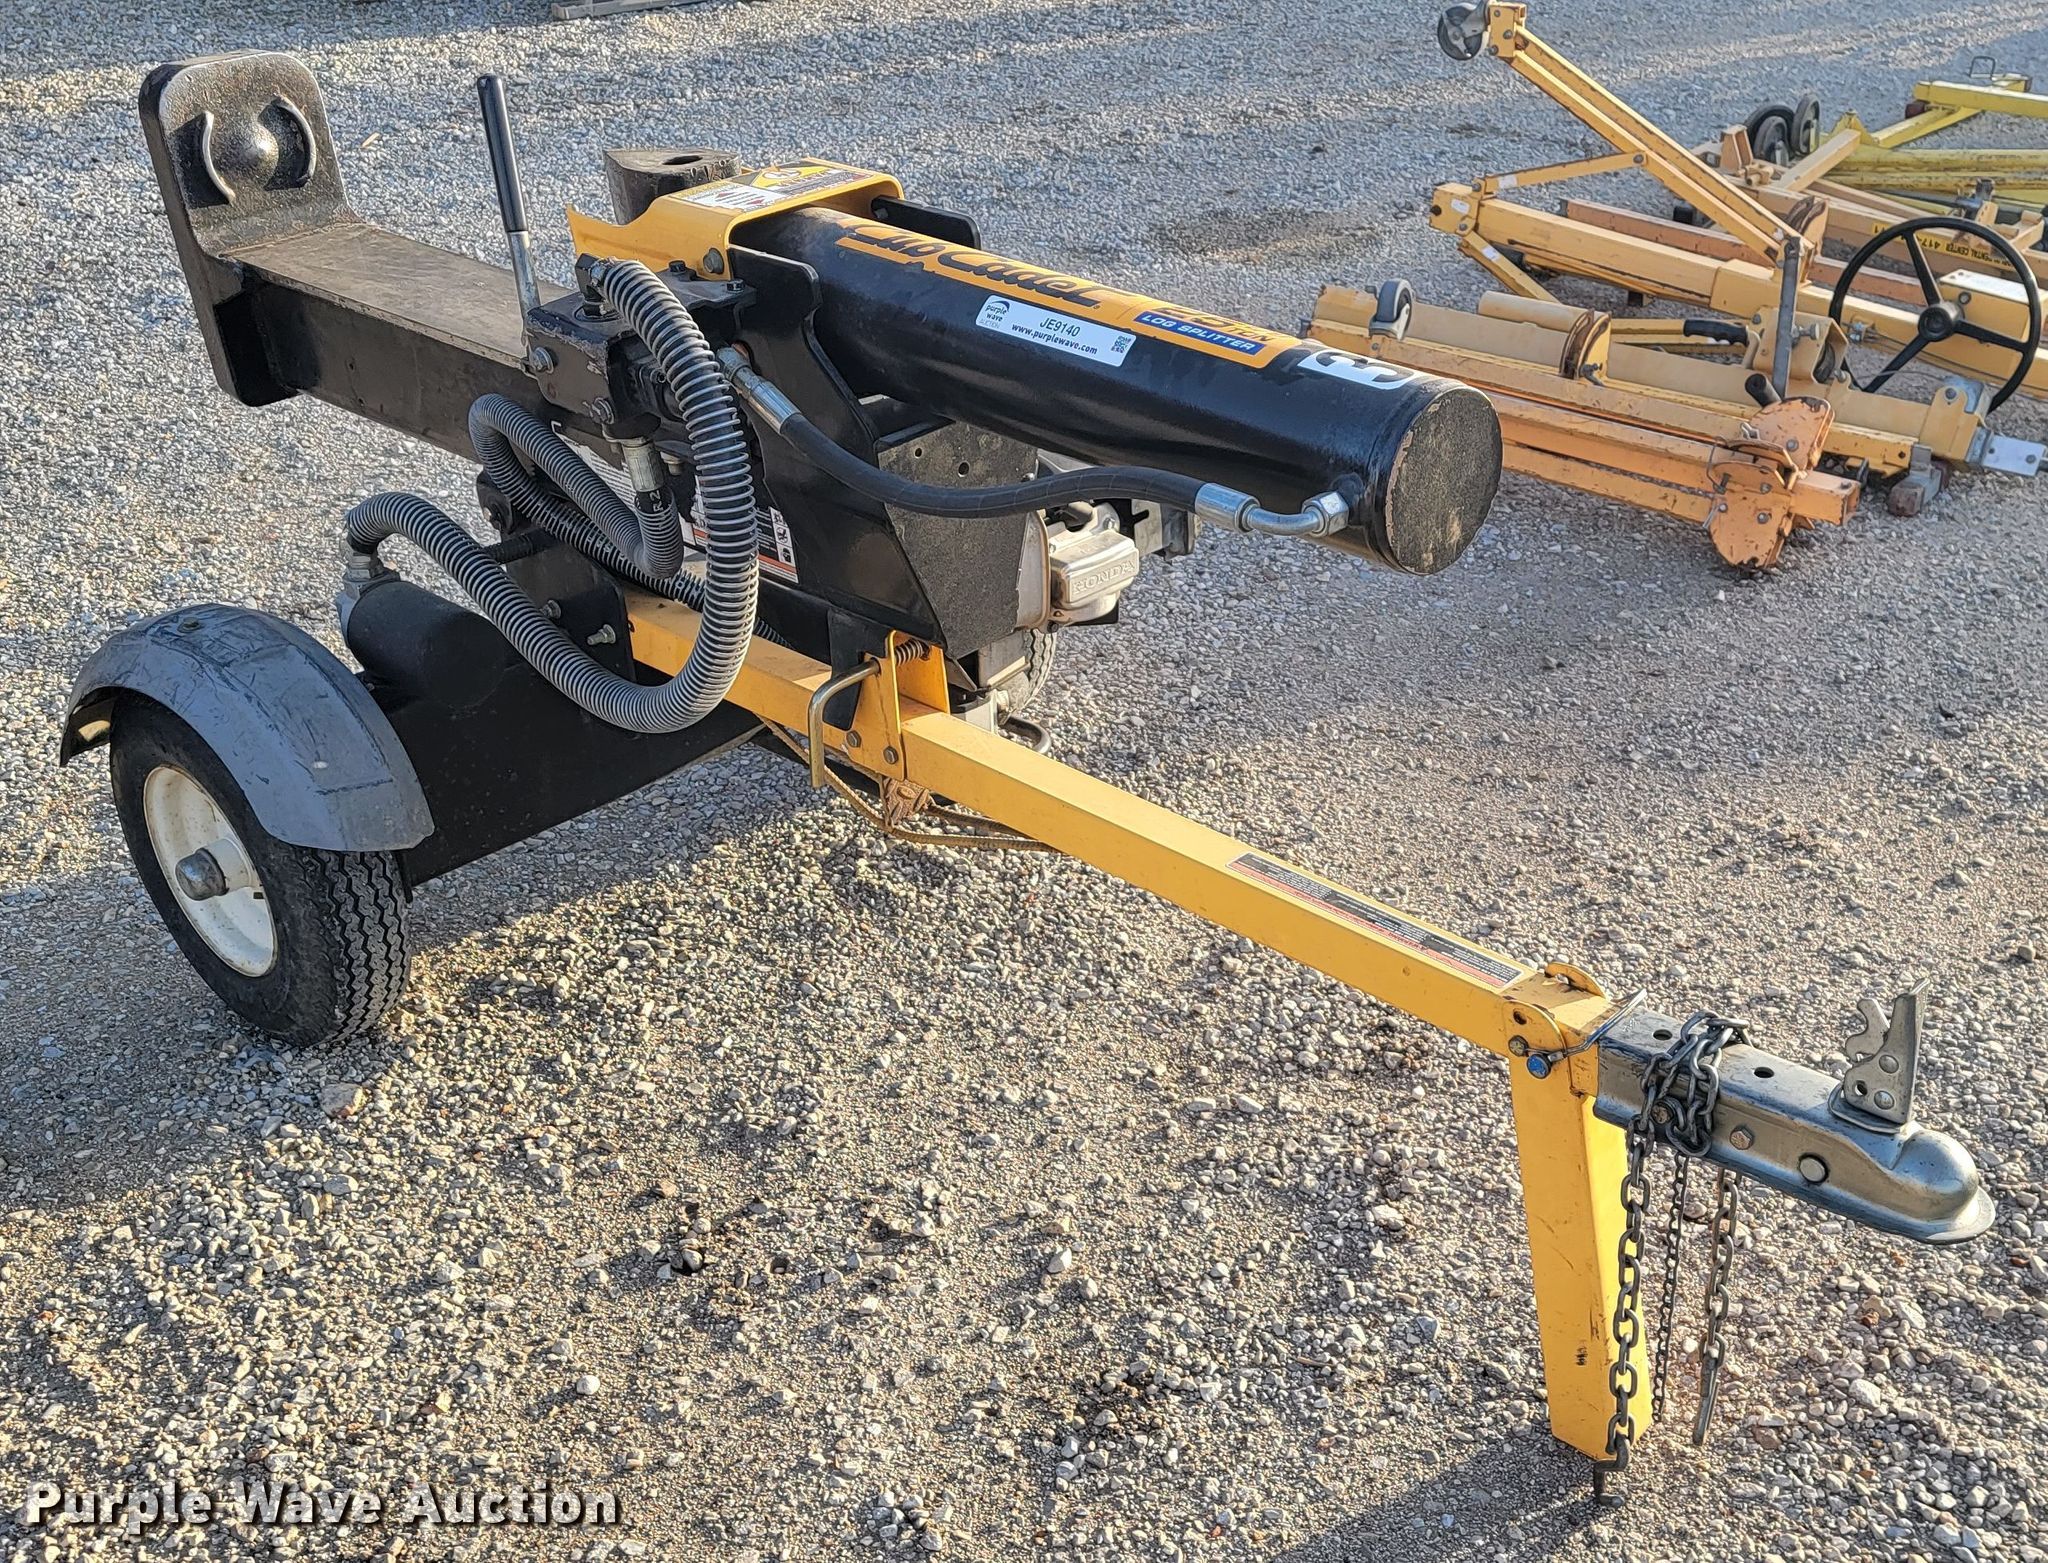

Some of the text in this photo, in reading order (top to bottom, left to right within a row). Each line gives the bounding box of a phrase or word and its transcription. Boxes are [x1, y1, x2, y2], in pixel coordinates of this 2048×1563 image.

[845, 224, 1100, 307] Cub Cadet
[985, 304, 1008, 315] purple
[986, 313, 1003, 322] wave
[1012, 323, 1098, 354] www.purplewave.com
[1040, 317, 1081, 337] JE9140
[1142, 314, 1256, 350] LOG SPLITTER
[1073, 560, 1135, 594] HONDA
